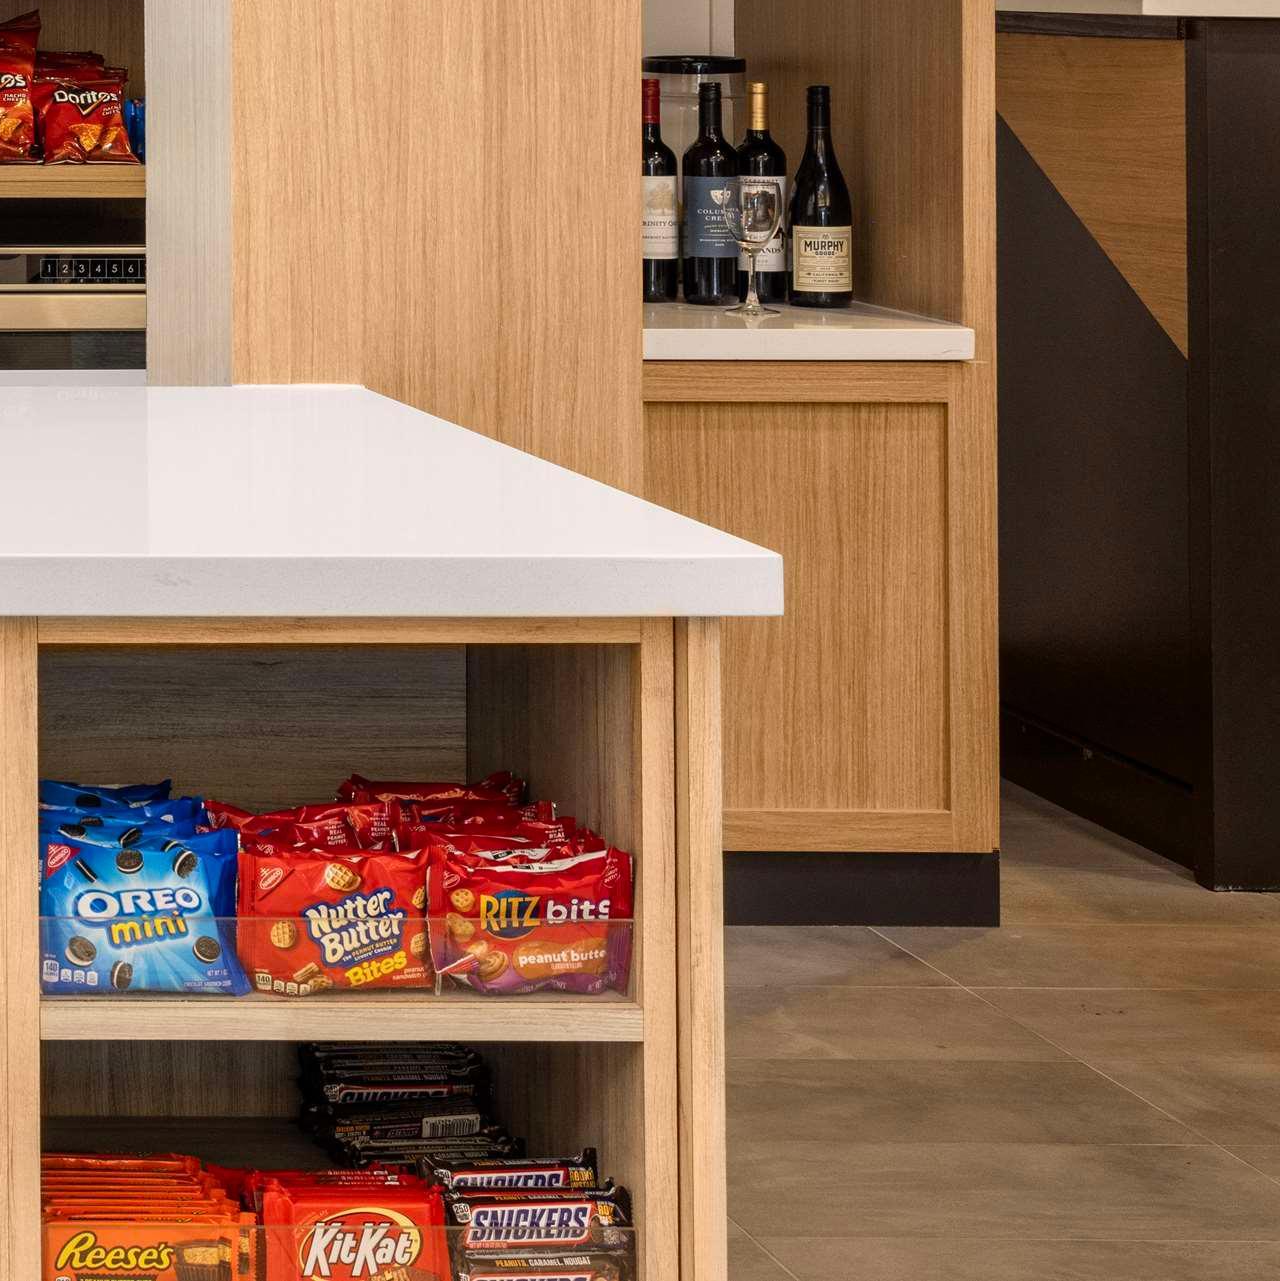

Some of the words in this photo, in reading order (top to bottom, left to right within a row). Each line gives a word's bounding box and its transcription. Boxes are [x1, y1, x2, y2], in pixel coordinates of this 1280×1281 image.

[54, 90, 117, 103] Doritos
[804, 240, 844, 251] MURPHY
[48, 847, 70, 867] NABISCO
[78, 888, 200, 919] OREO
[305, 891, 390, 937] Nutter
[480, 895, 541, 931] RITZ
[112, 911, 186, 944] mini
[321, 912, 403, 963] Butter
[45, 962, 58, 972] 140
[345, 951, 407, 986] Bites
[518, 952, 567, 967] peanut
[455, 1204, 468, 1213] 250
[472, 1207, 589, 1241] SNICKERS
[56, 1232, 174, 1269] Reese's
